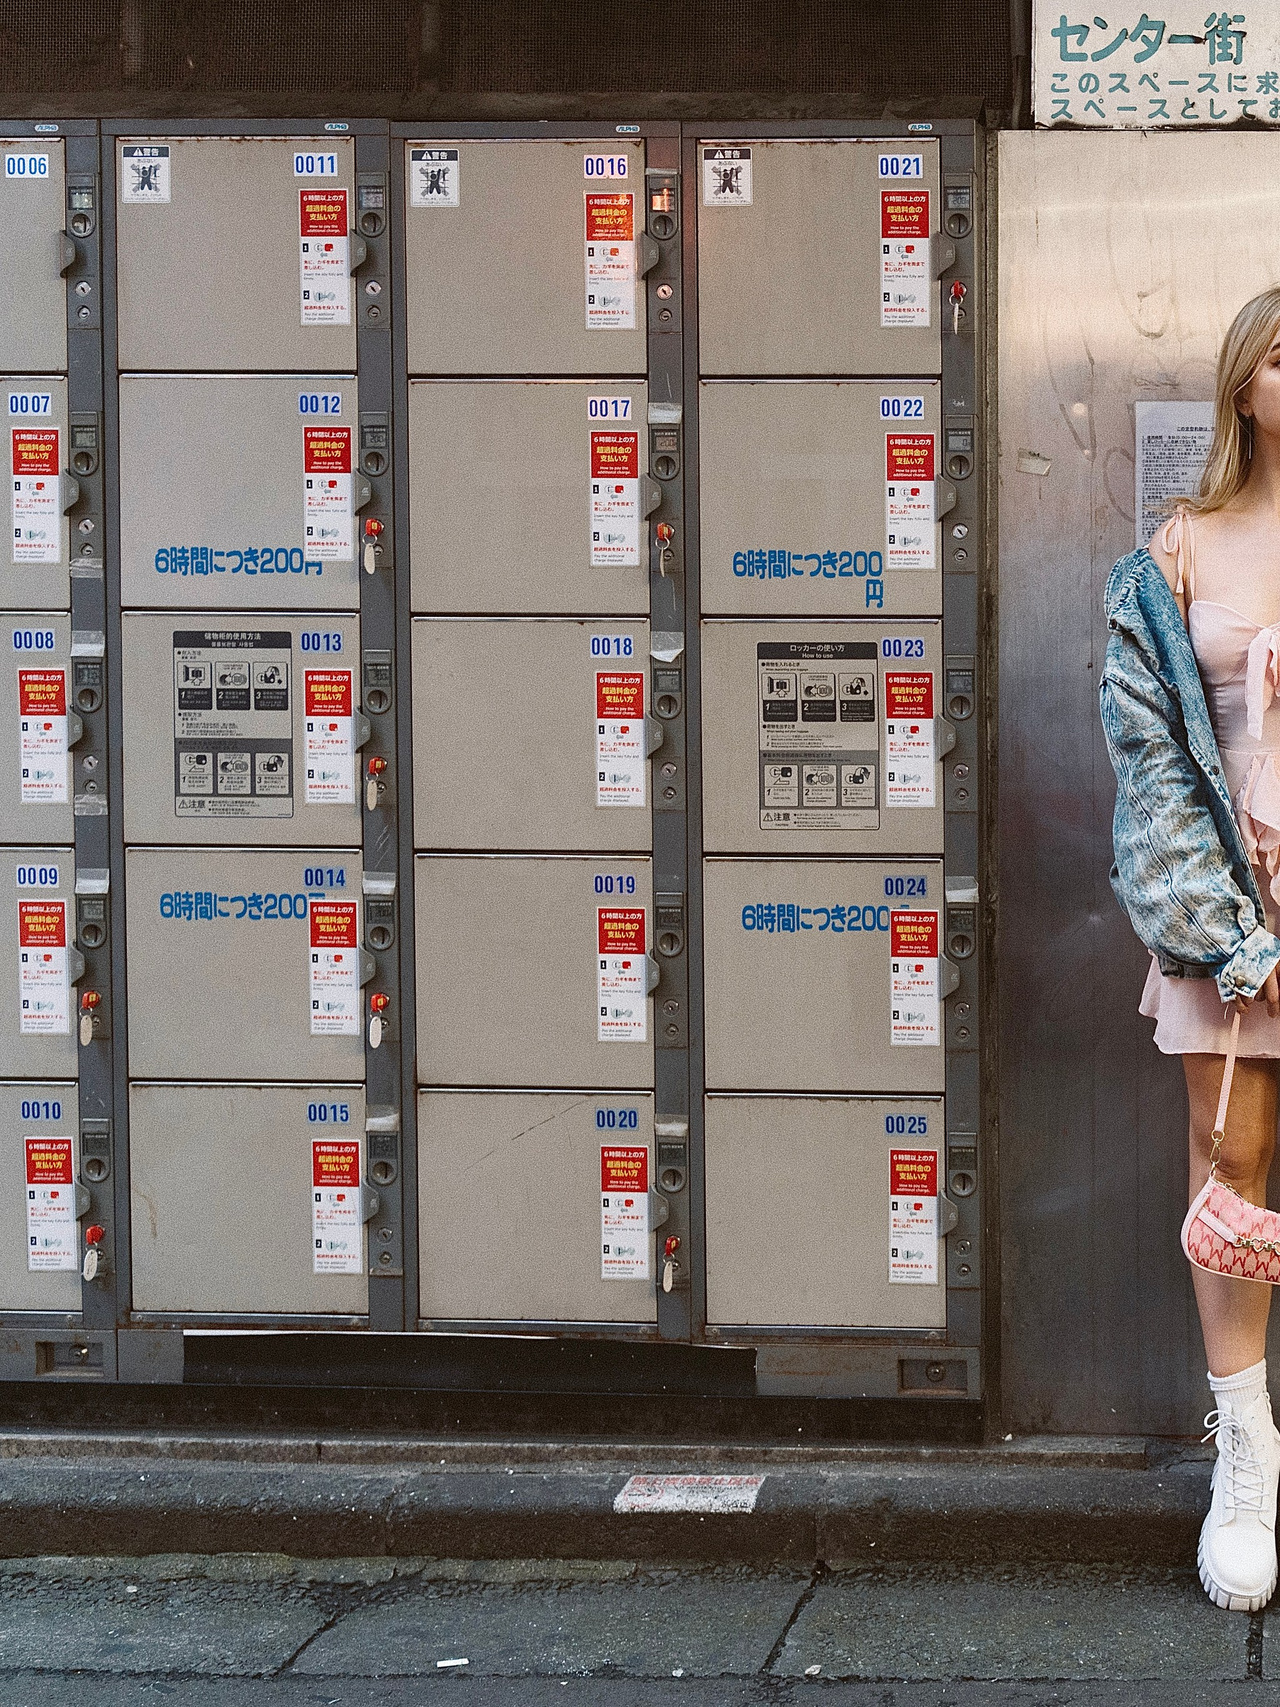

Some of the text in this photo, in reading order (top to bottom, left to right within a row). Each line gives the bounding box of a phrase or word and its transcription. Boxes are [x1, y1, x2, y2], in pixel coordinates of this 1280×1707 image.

[1051, 12, 1246, 65] センター街
[7, 157, 47, 176] 0006
[295, 155, 335, 174] 0011
[585, 157, 626, 176] 0016
[879, 157, 920, 176] 0021
[9, 395, 50, 414] 0007
[299, 394, 341, 414] 0012
[589, 399, 630, 418] 0017
[881, 398, 923, 417] 0022
[865, 579, 885, 609] 円
[13, 631, 54, 649] 0008
[301, 632, 342, 652] 0013
[591, 637, 633, 656] 0018
[789, 644, 845, 652] ロッカーの使い方
[882, 638, 924, 658] 0023
[773, 813, 791, 822] 注意
[17, 867, 58, 885] 0009
[304, 868, 346, 887] 0014
[594, 875, 635, 894] 0019
[884, 877, 927, 896] 0024
[160, 891, 327, 922] 6時間につき200
[742, 903, 910, 935] 6時間につき200
[21, 1101, 61, 1120] 0010
[308, 1103, 349, 1123] 0015
[596, 1109, 638, 1129] 0020
[885, 1115, 927, 1134] 0025
